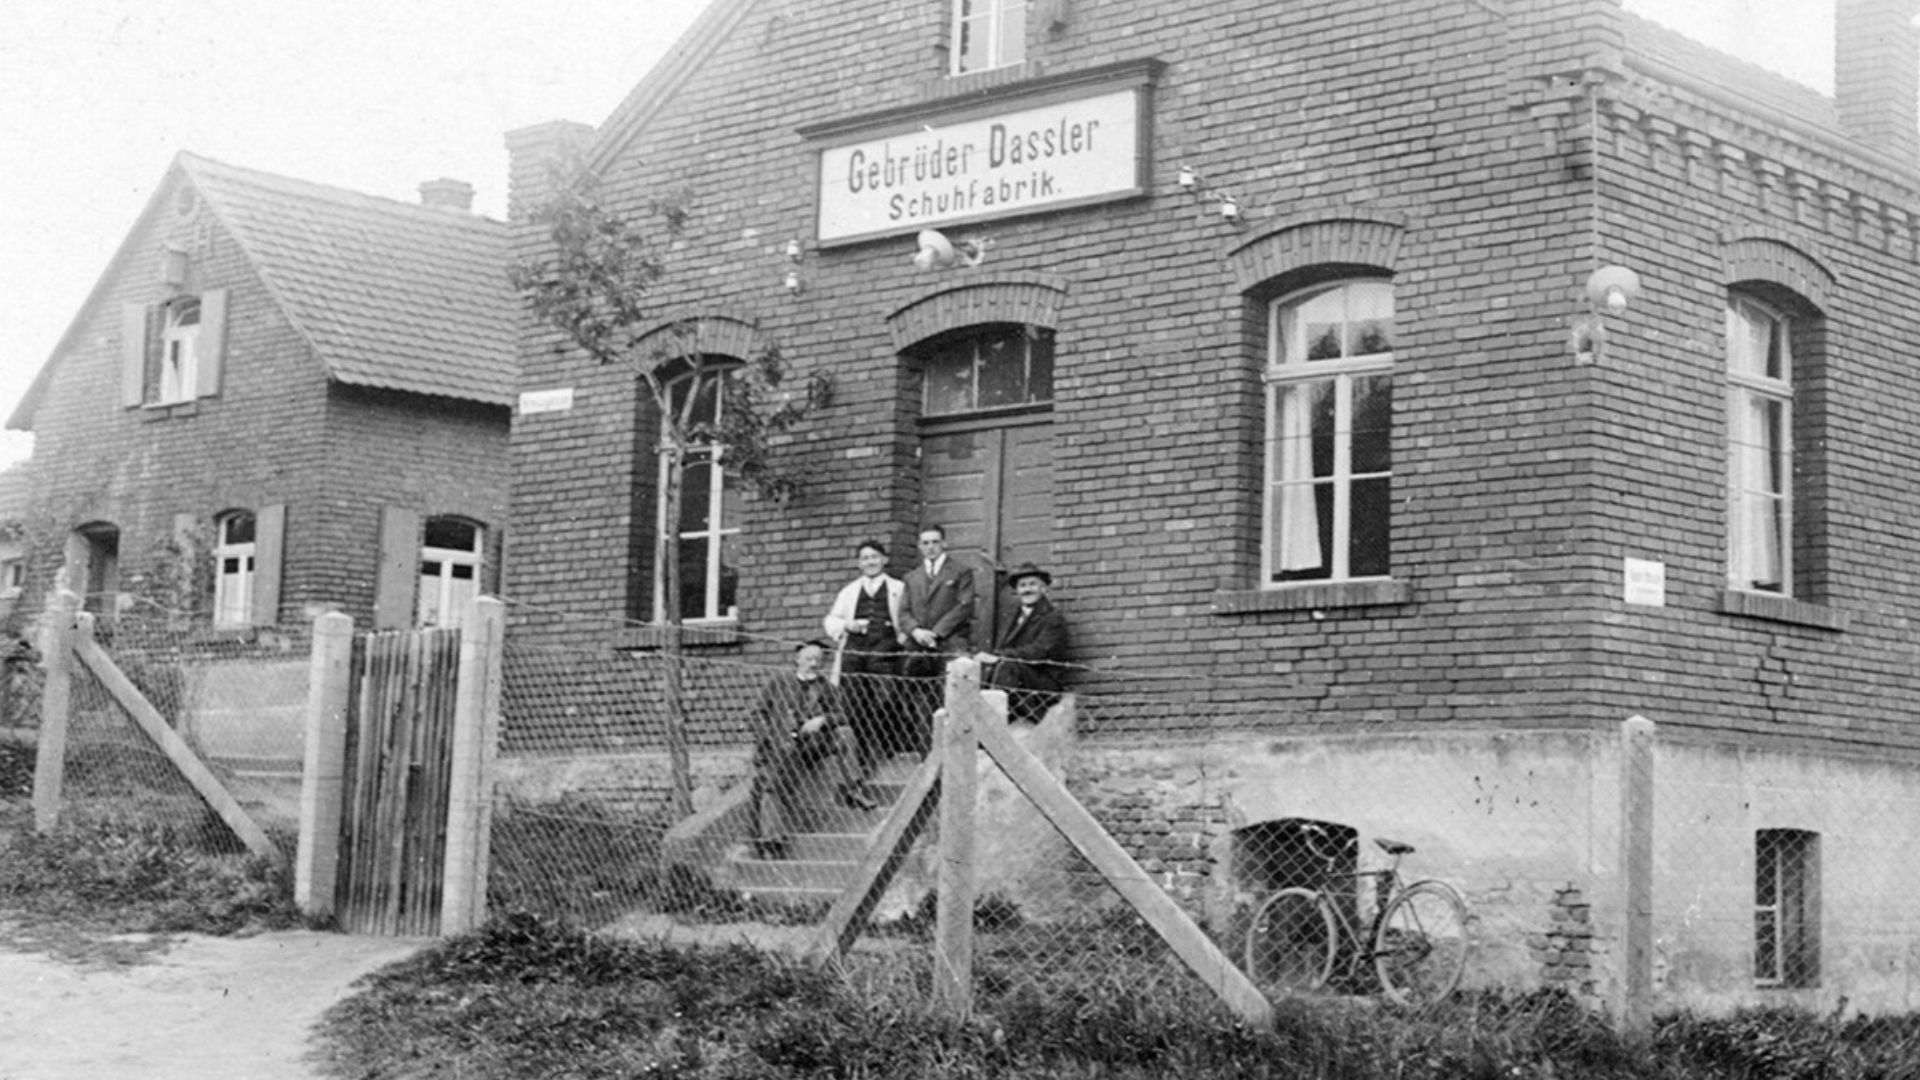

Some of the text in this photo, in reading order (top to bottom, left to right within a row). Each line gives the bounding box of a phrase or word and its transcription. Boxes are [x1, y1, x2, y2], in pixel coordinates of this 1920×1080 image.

[848, 118, 1100, 194] Gebrüder Dassler
[888, 171, 1063, 220] Schuhfabrik.
